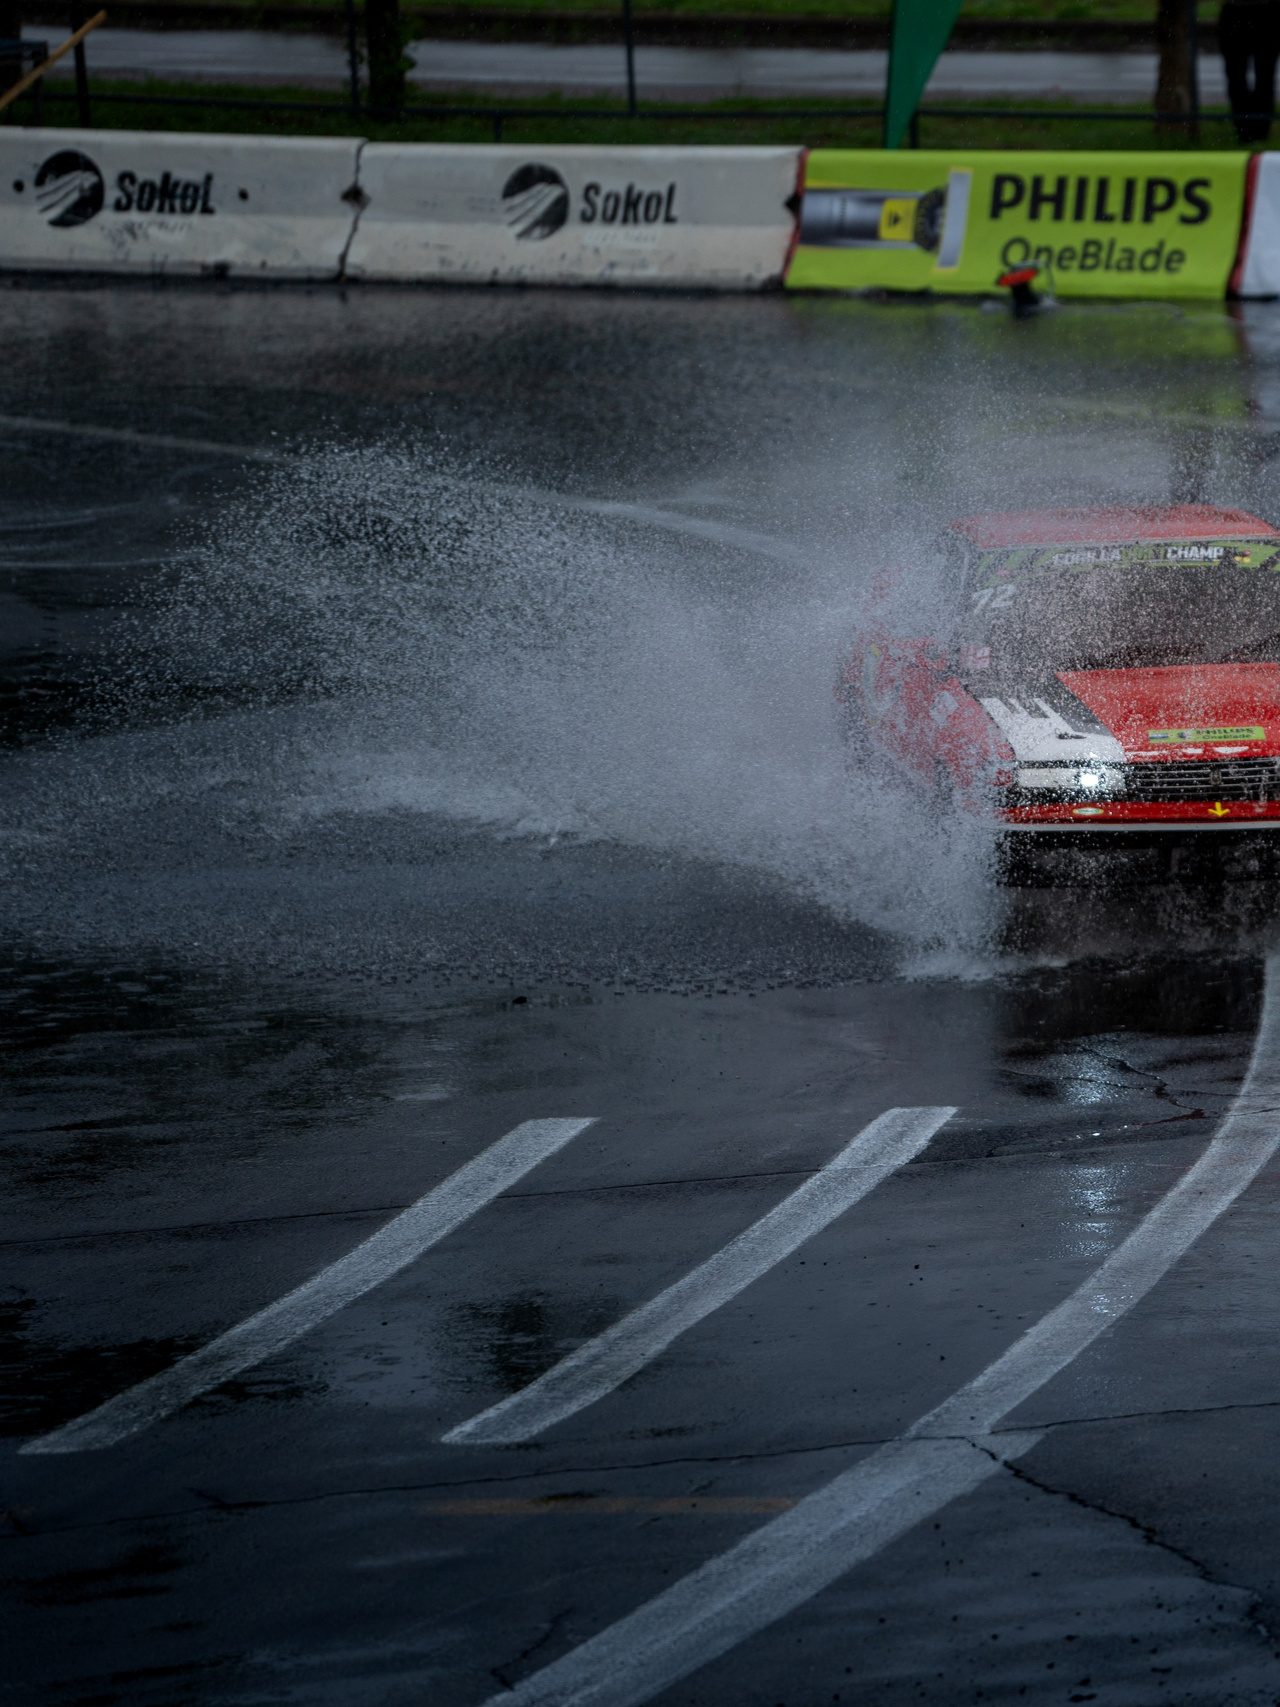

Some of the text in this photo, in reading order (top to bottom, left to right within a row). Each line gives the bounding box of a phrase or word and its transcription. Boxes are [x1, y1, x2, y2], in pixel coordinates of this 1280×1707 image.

[990, 173, 1213, 226] PHILIPS
[1001, 236, 1187, 274] OneBlade
[1166, 546, 1224, 560] CHAMP
